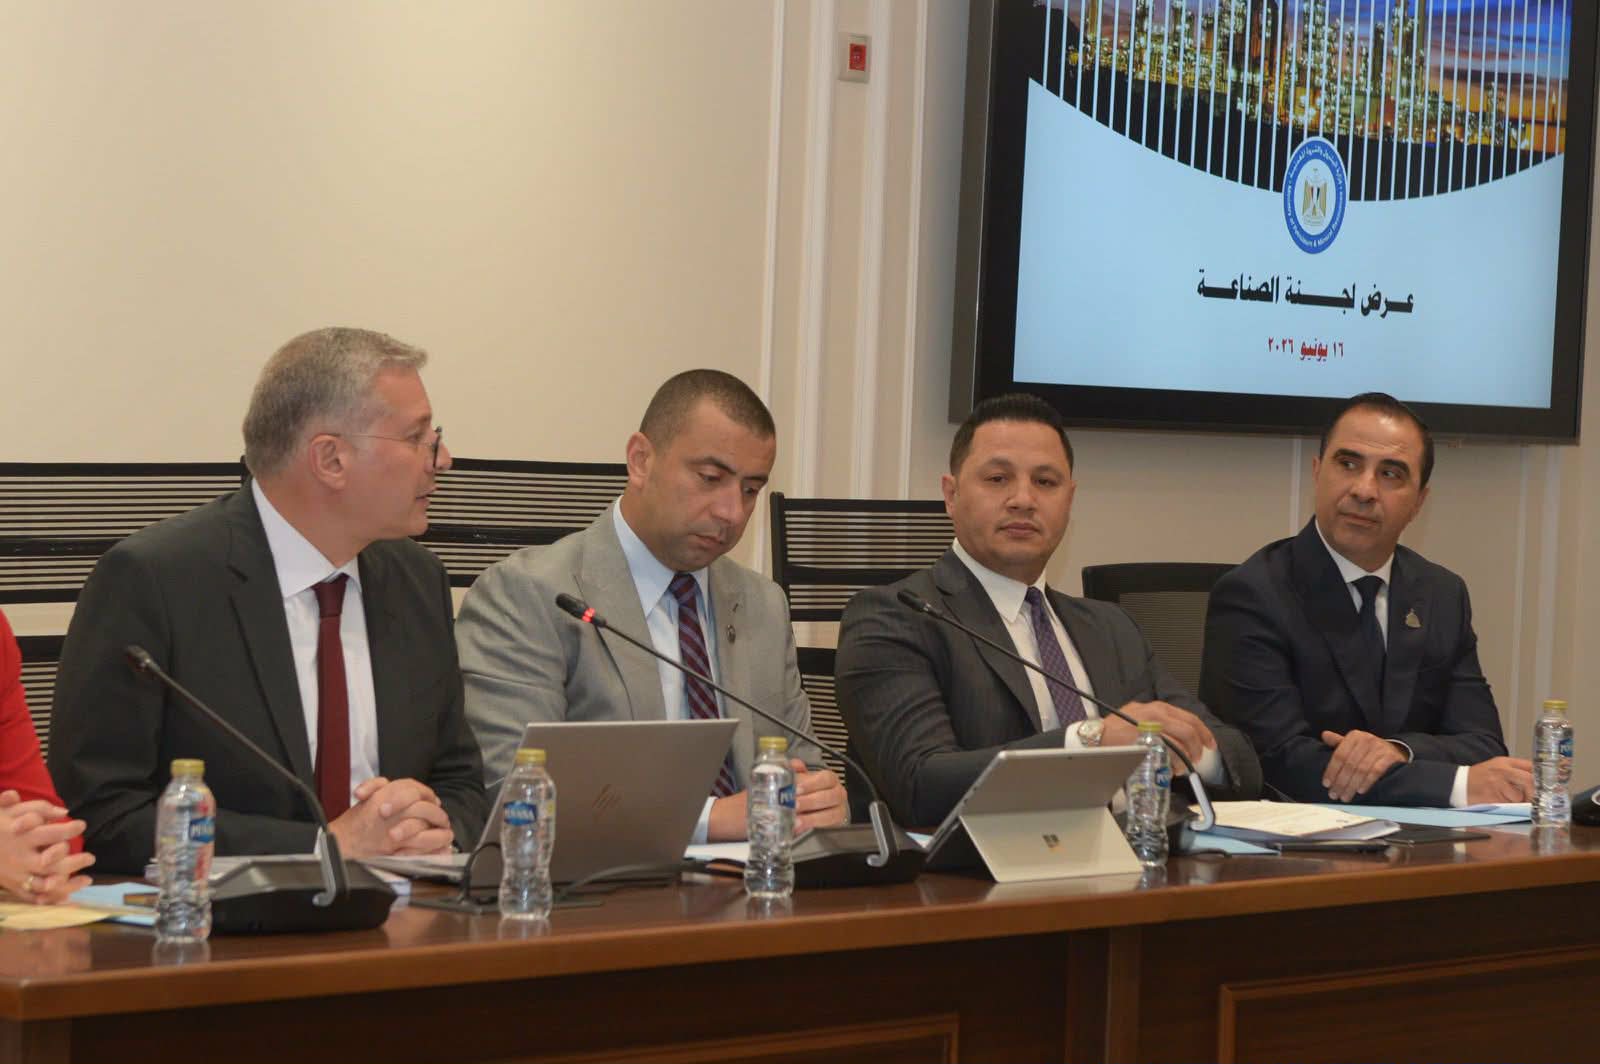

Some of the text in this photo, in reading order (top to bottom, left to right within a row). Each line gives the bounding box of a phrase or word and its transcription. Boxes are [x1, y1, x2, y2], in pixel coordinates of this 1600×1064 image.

[1197, 268, 1414, 319] عرض لجنة الصناعة
[1300, 338, 1328, 362] يونيو
